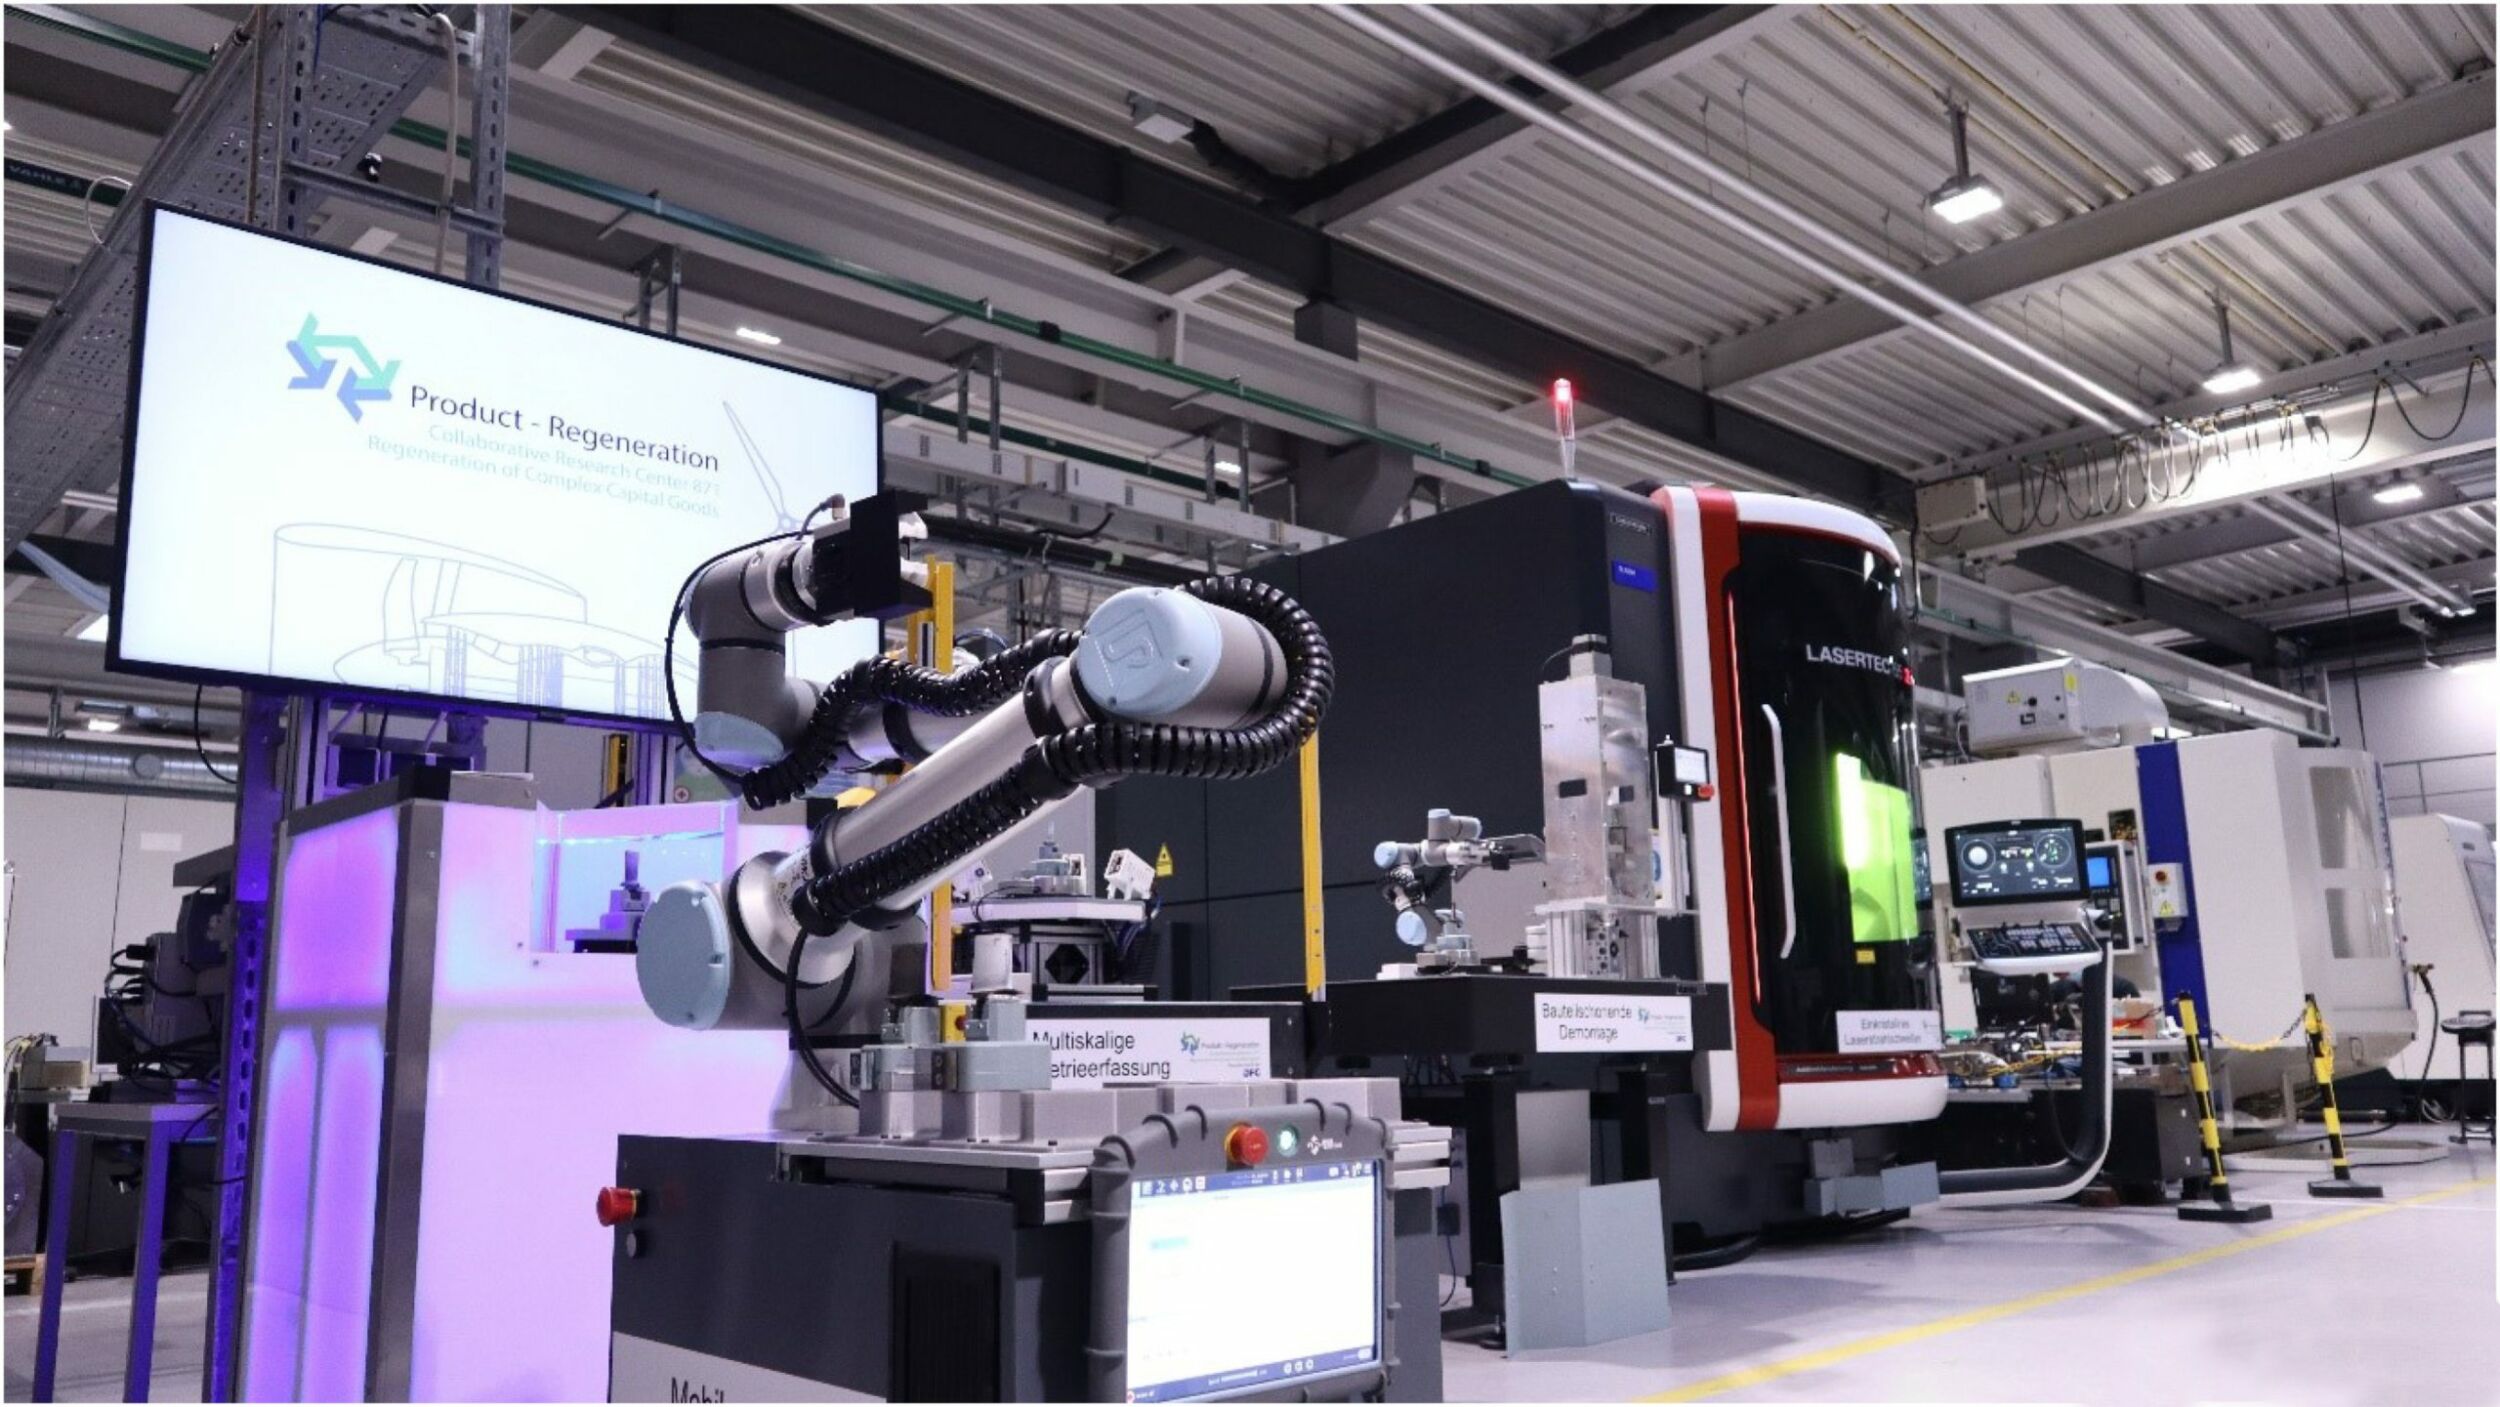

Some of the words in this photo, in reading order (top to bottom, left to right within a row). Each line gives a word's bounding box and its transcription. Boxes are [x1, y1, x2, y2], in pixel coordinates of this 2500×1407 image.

[411, 385, 523, 431] Product
[549, 415, 719, 472] Regeneration
[368, 434, 497, 474] Regeneration
[502, 463, 521, 479] of
[525, 465, 600, 494] Complex
[606, 483, 664, 505] Capital
[667, 494, 720, 519] Goods
[429, 424, 550, 462] Collaborative
[556, 450, 630, 479] Research
[635, 468, 688, 489] Center
[1806, 643, 1892, 675] LASERTEC
[1033, 1030, 1135, 1054] Multiskalige
[1050, 1057, 1171, 1080] etrieerfassung
